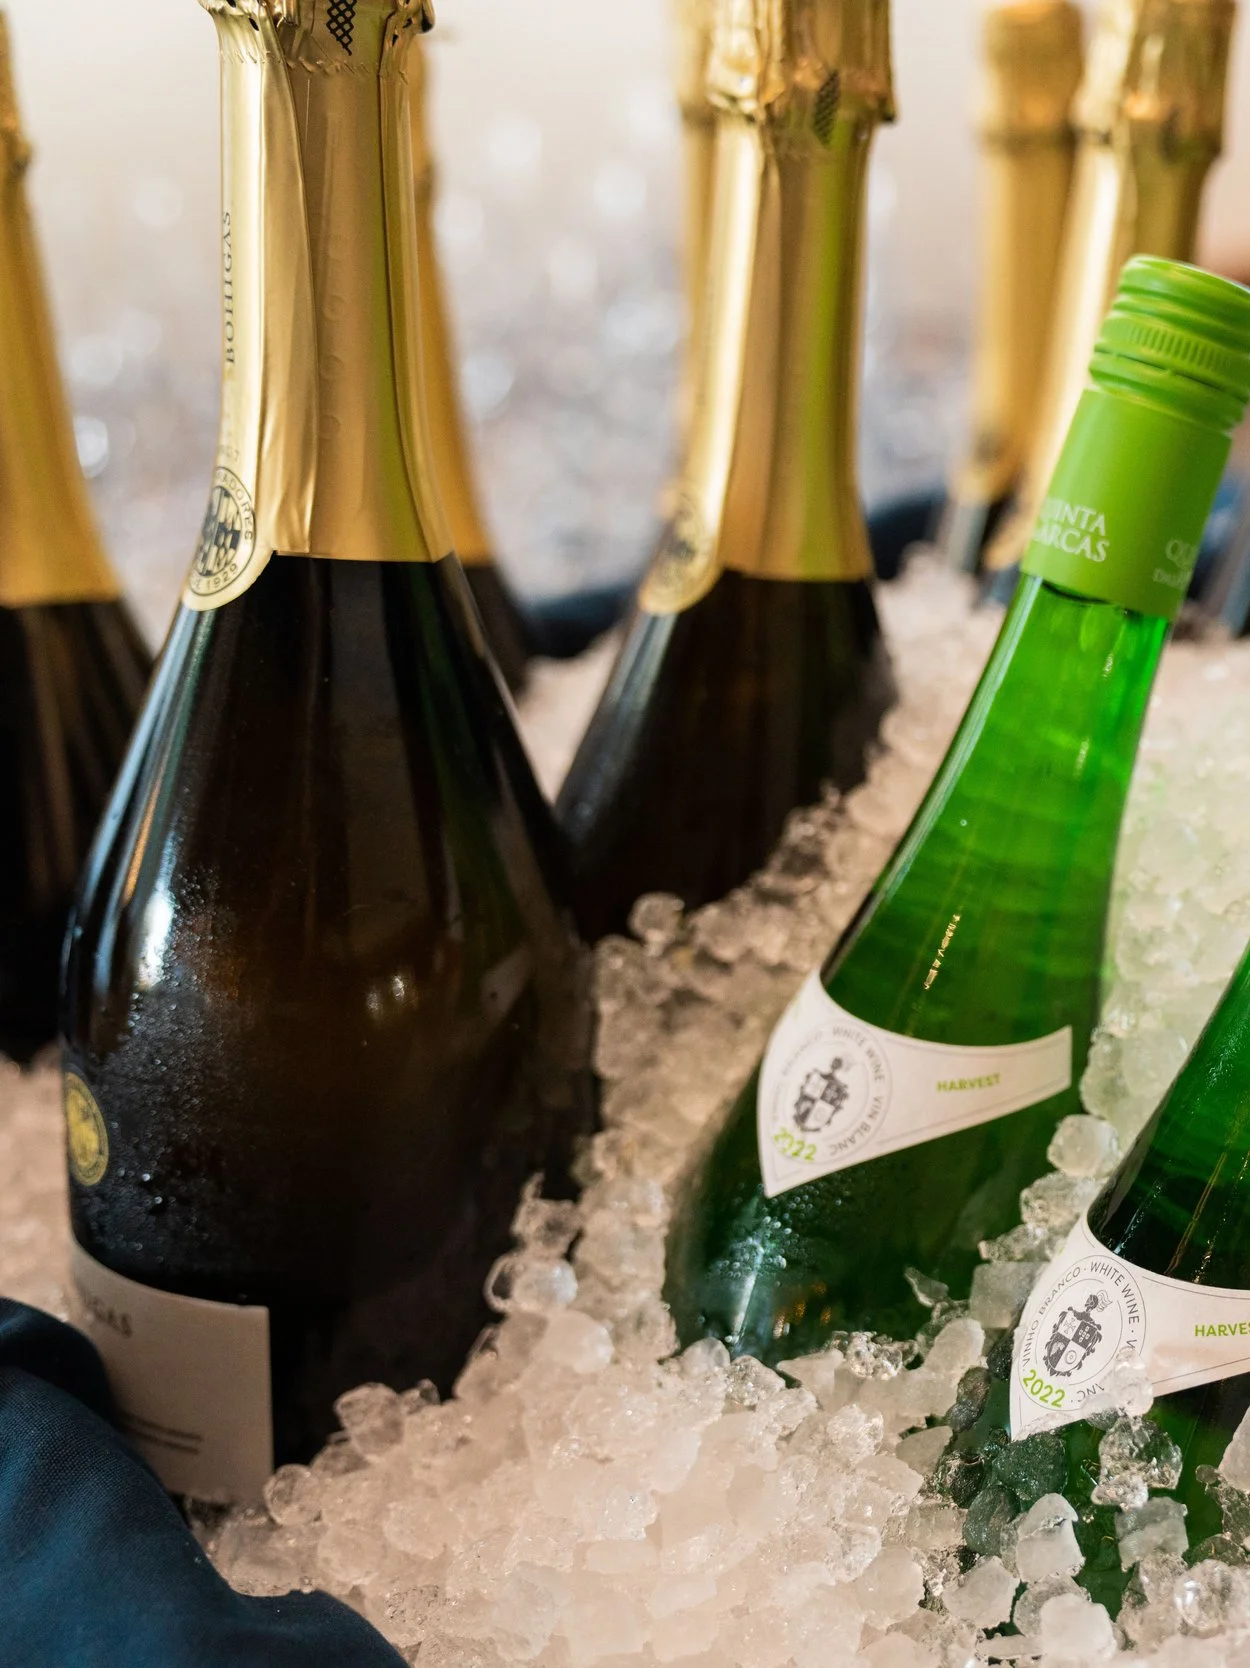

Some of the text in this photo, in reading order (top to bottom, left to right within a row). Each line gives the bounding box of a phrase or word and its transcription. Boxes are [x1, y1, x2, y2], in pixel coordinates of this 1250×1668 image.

[866, 1048, 885, 1082] WINE
[937, 1072, 1002, 1093] HARVEST
[868, 1095, 884, 1121] VIN
[829, 1124, 872, 1156] BLANC
[1023, 1260, 1140, 1367] VINHO BRANCO WHITE WINE
[1023, 1369, 1066, 1408] 2022
